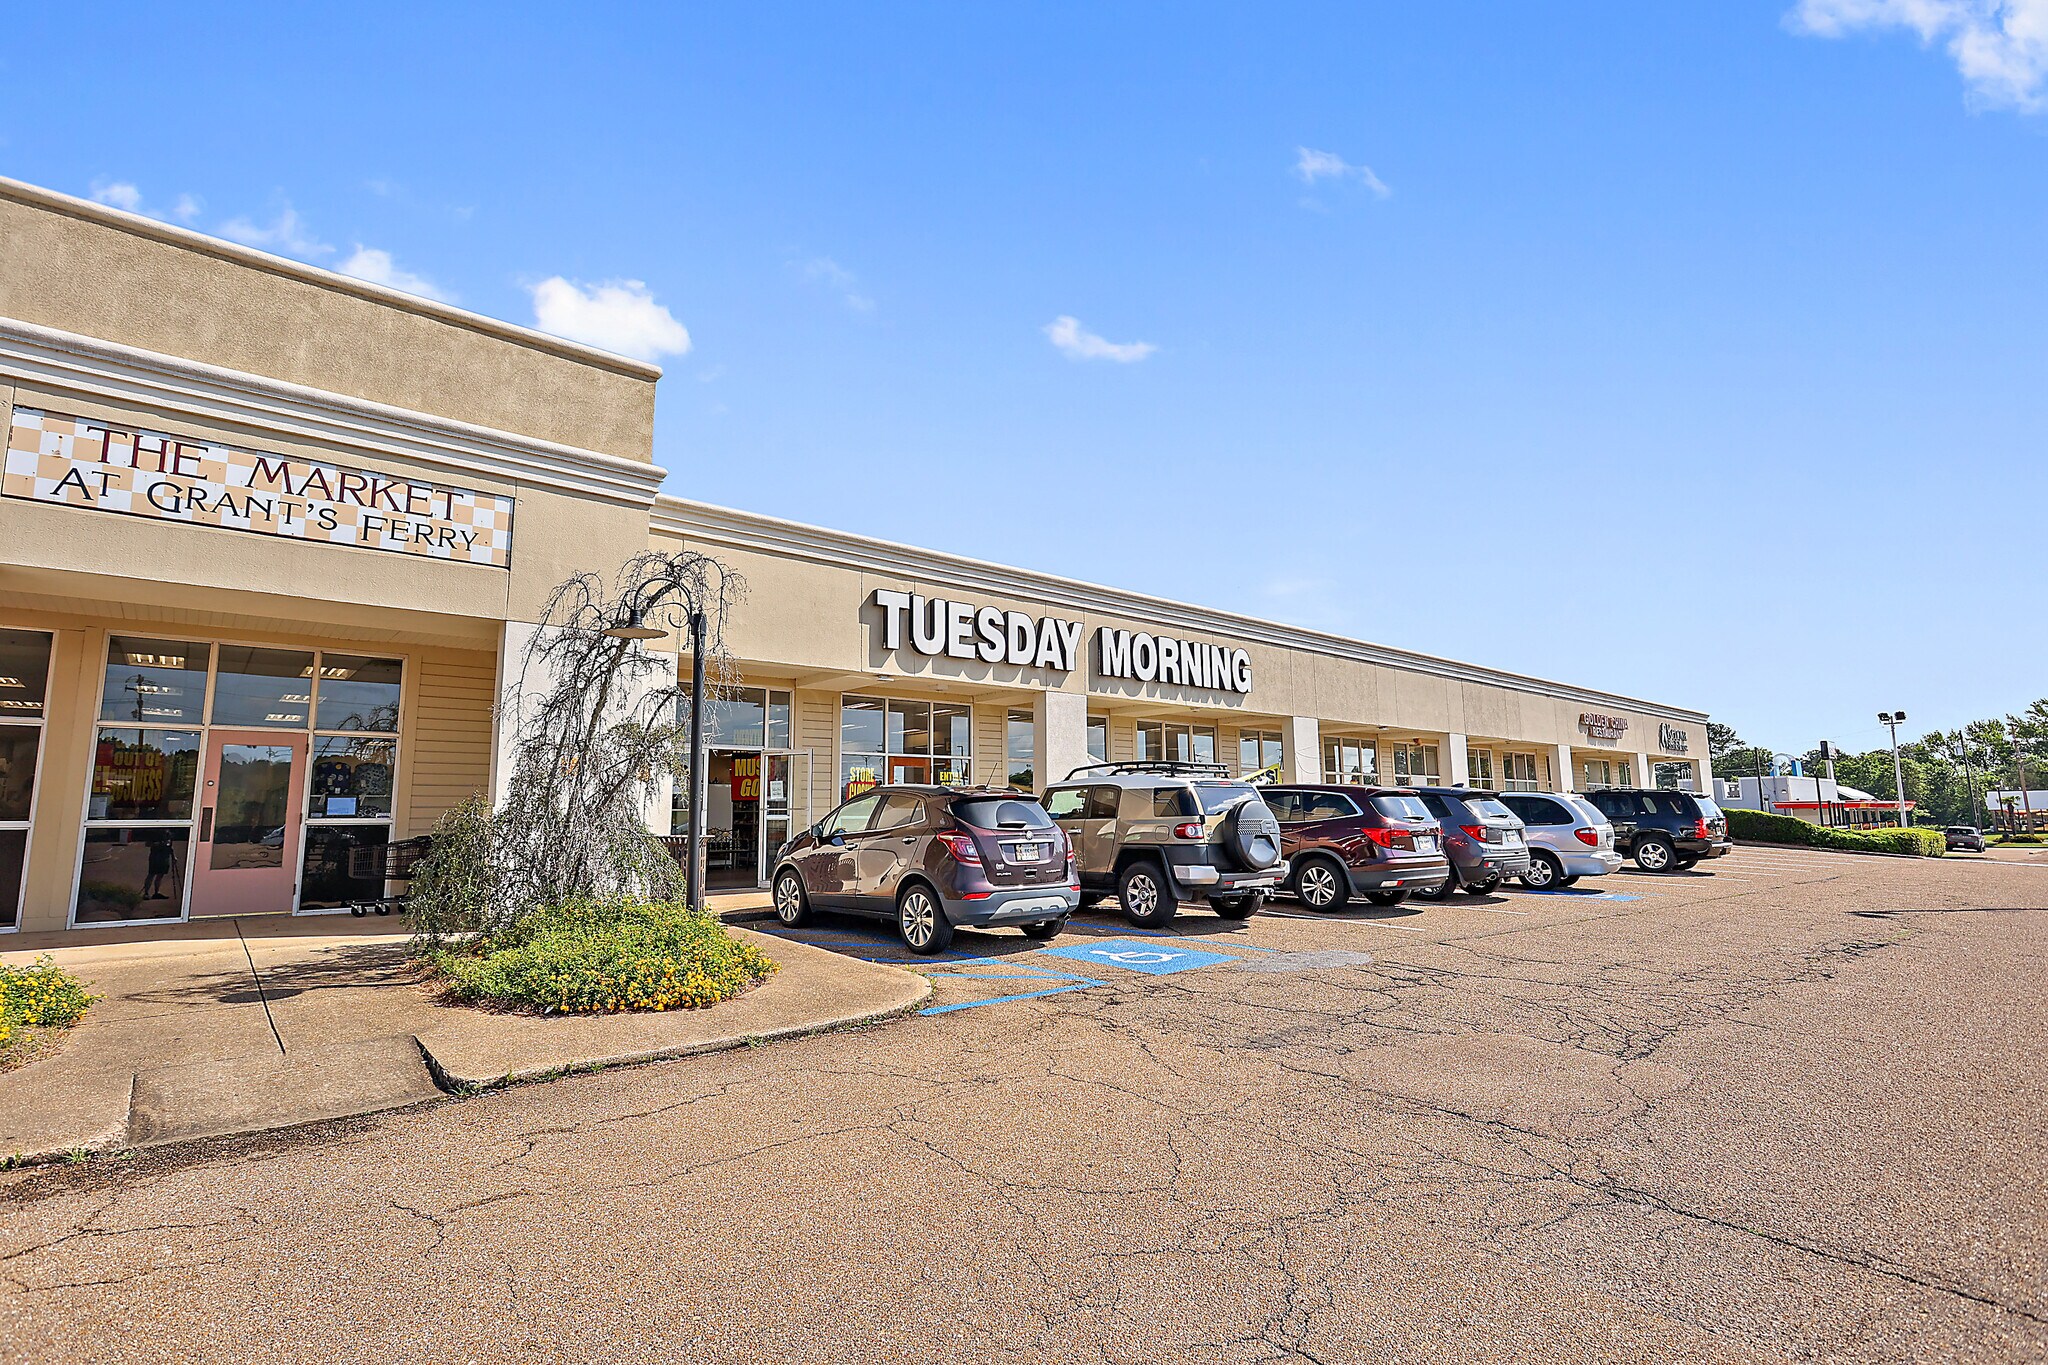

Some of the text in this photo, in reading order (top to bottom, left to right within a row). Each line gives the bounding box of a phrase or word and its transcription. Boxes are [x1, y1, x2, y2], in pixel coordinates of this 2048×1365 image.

[87, 425, 463, 521] THE MARKET
[50, 467, 479, 552] AT GRANT'S FERRY
[875, 589, 1252, 694] TUESDAY MORNING
[1584, 712, 1629, 730] GOLDEN CHINA
[113, 752, 142, 766] OUT
[850, 766, 875, 782] STORE
